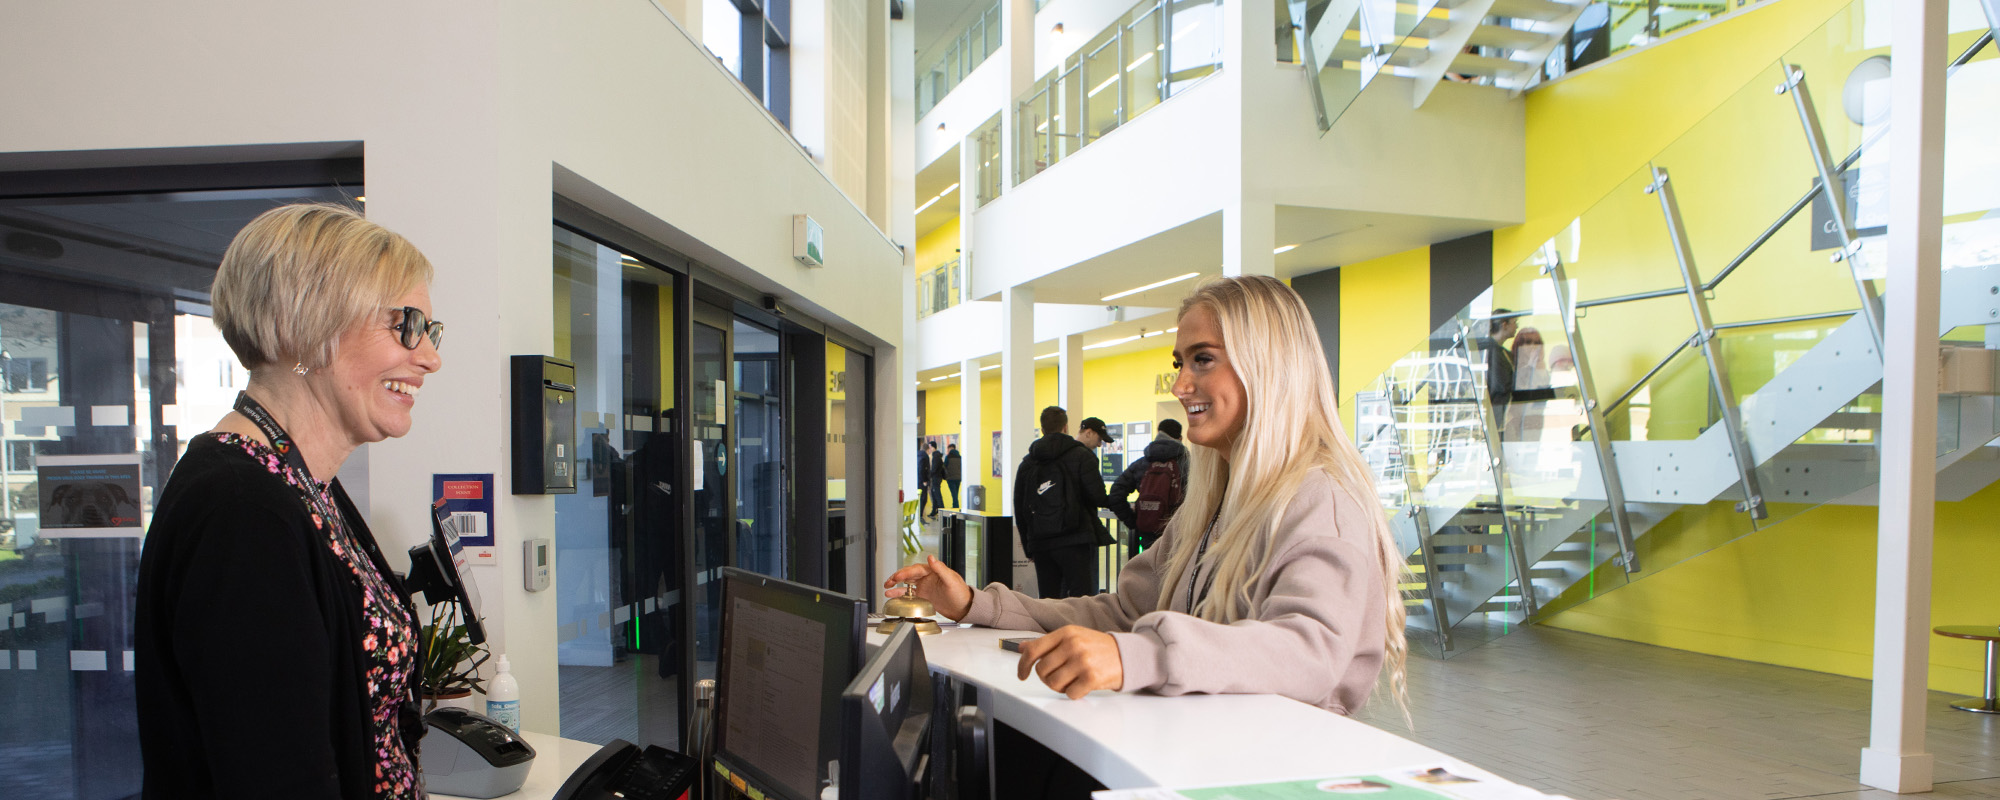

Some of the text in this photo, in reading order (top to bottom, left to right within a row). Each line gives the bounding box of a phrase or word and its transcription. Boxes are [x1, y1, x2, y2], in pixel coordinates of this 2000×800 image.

[243, 405, 262, 423] Yorkshir
[263, 423, 278, 440] Heart
[266, 416, 284, 437] Education
[297, 467, 314, 495] Yorkshire
